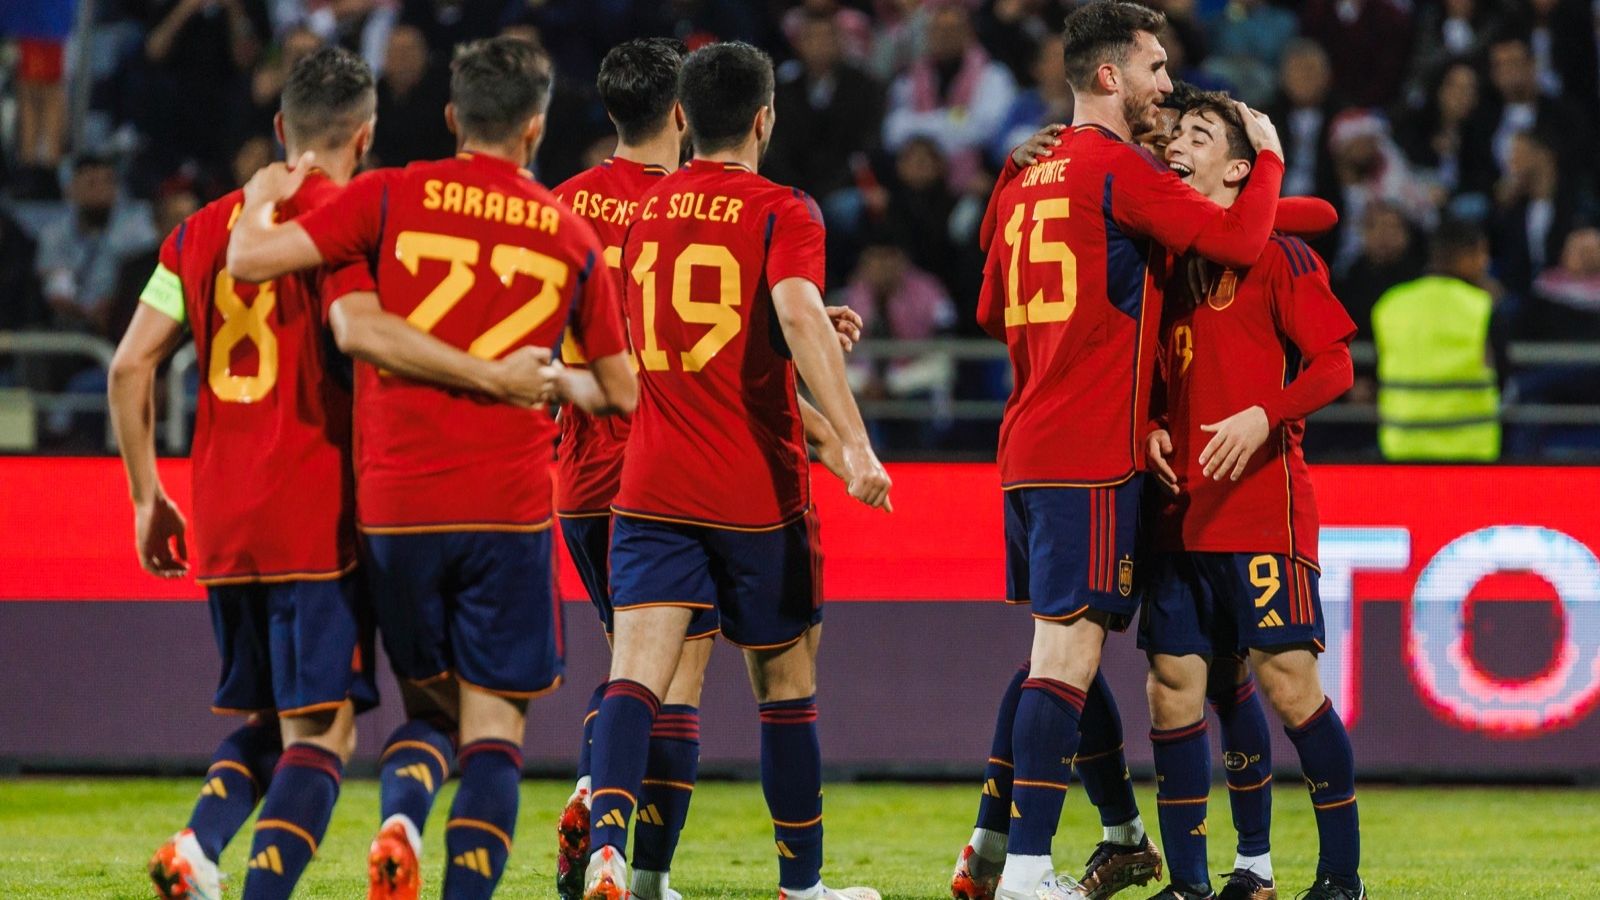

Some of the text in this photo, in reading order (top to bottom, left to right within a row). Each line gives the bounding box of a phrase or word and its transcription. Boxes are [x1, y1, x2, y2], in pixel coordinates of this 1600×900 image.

[1021, 158, 1071, 188] LAPORTE
[423, 180, 560, 235] SARABIA
[642, 192, 743, 224] C. SOLER
[1004, 197, 1077, 328] 15
[631, 241, 741, 373] 19
[208, 268, 278, 403] 8
[1174, 325, 1193, 375] 9
[1248, 554, 1281, 608] 9
[1318, 525, 1600, 738] TO
